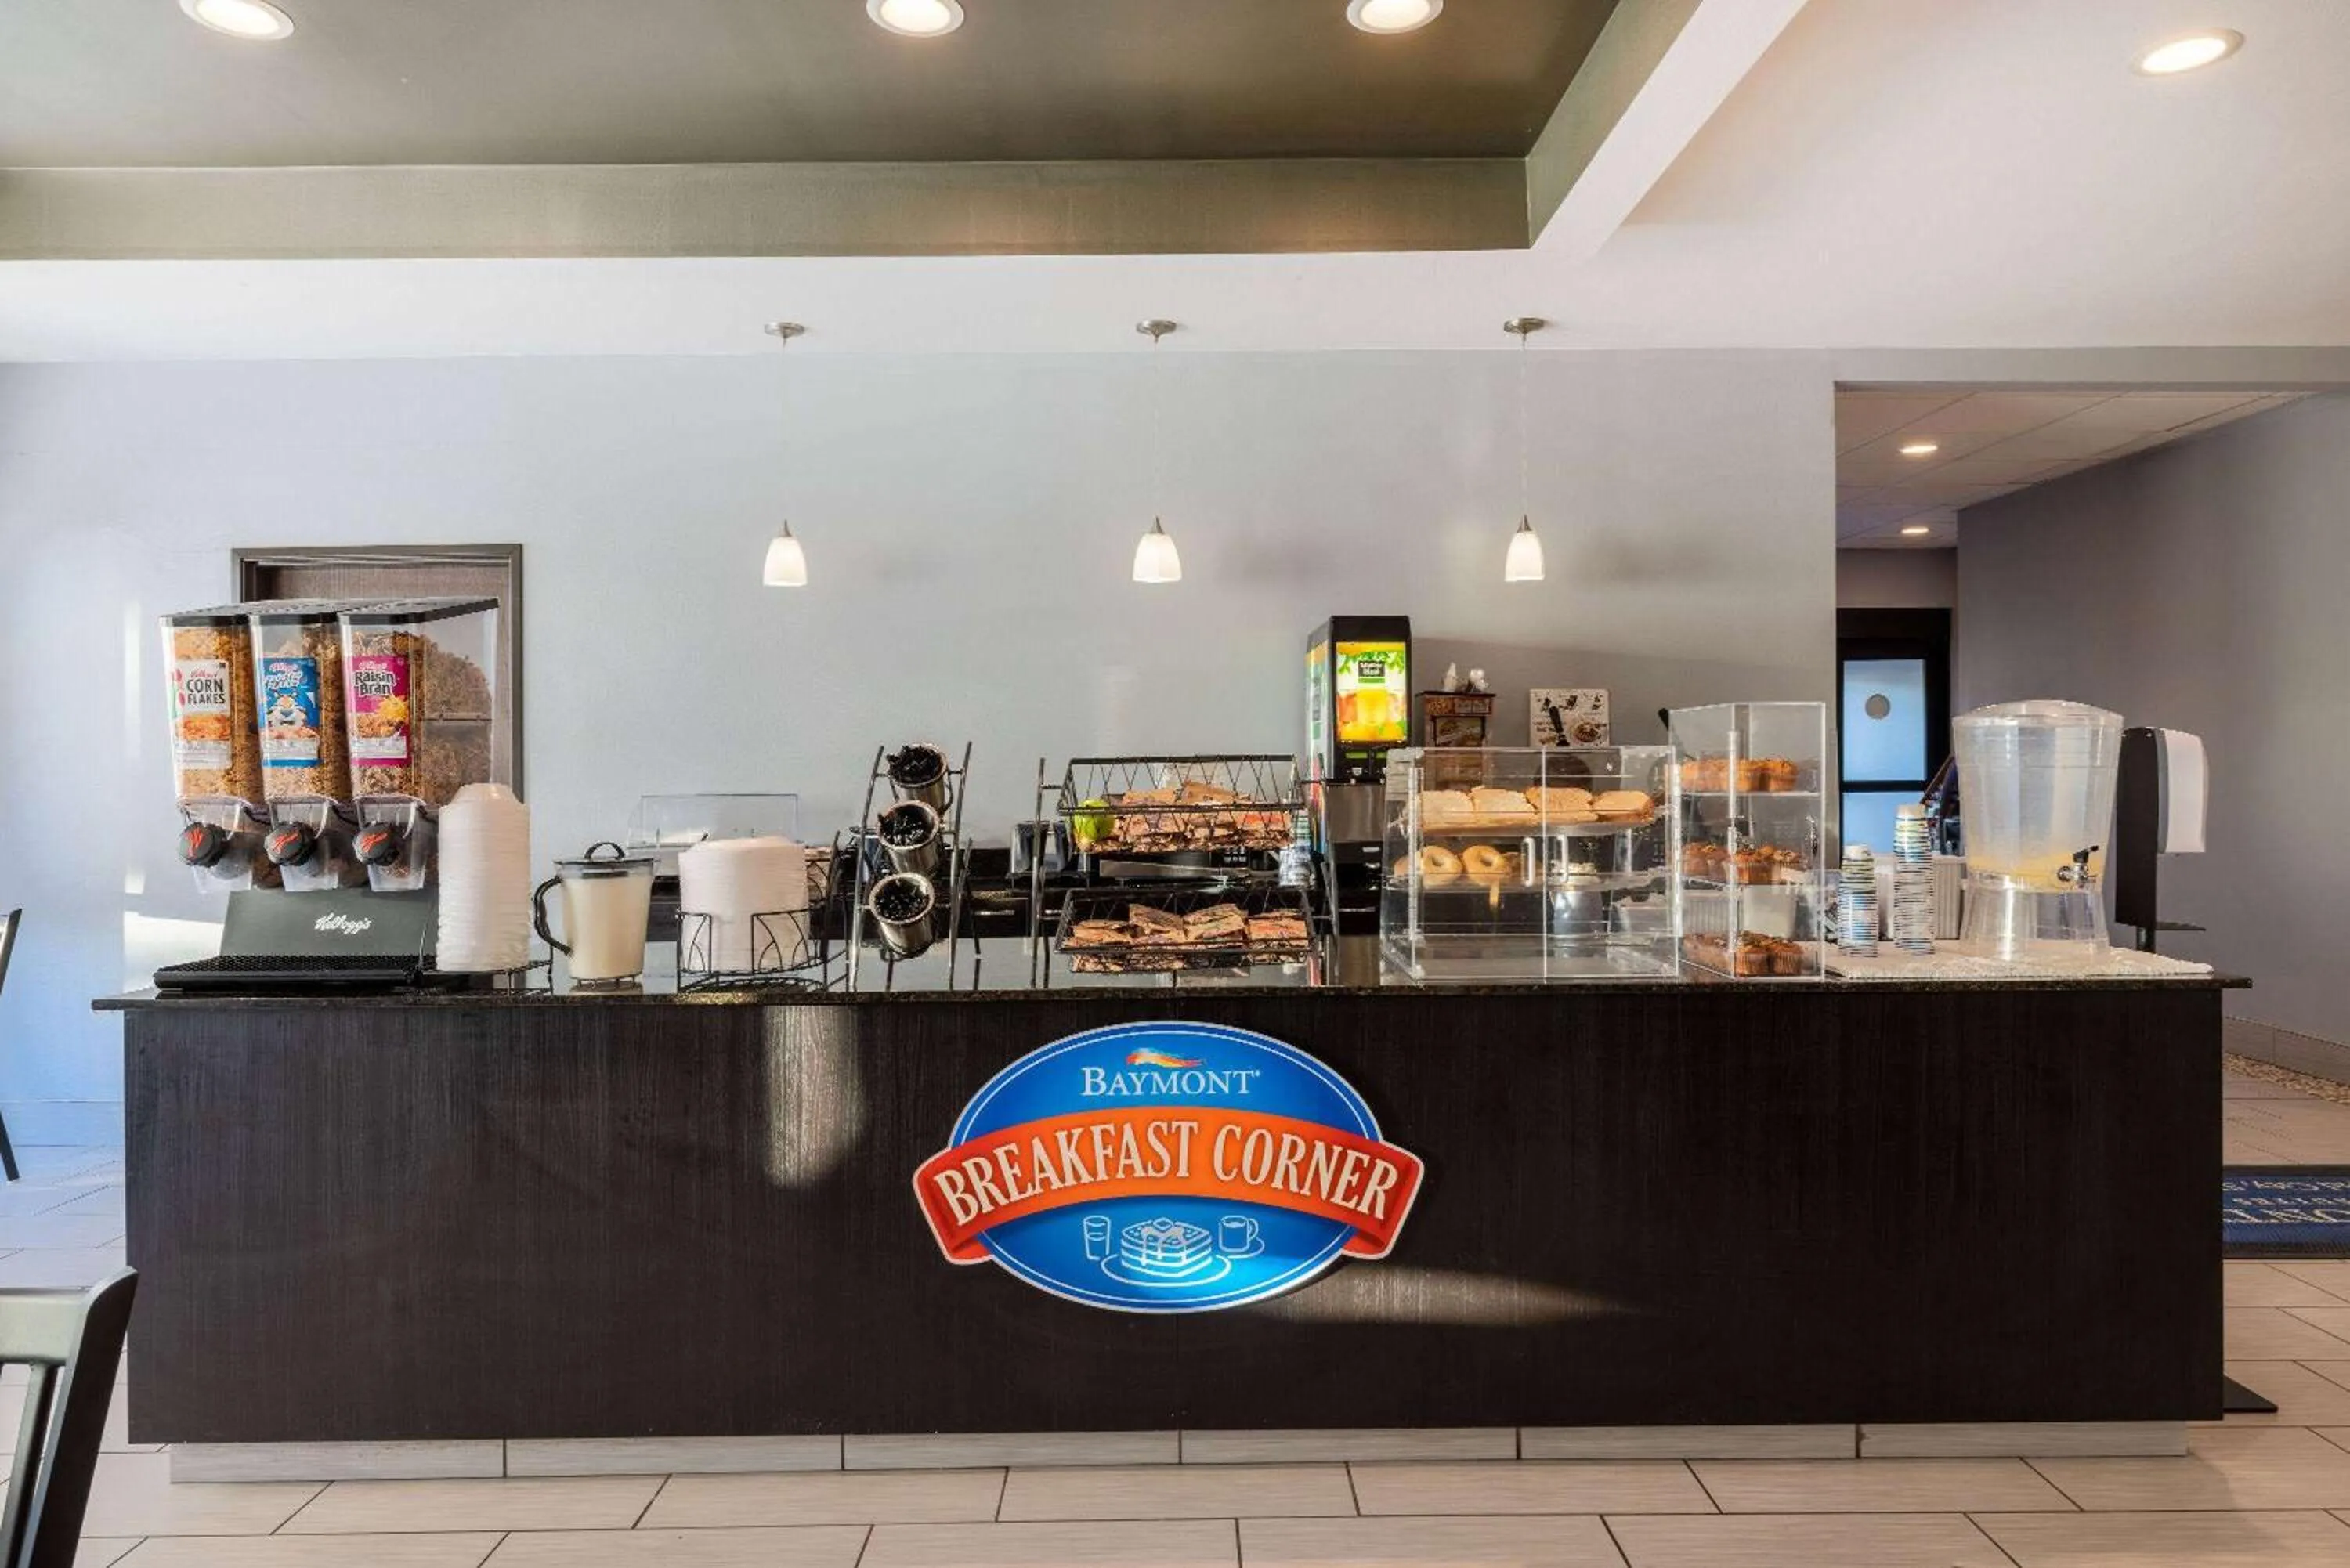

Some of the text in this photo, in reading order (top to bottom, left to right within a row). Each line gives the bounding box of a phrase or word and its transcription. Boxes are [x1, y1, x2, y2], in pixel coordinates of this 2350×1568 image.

[186, 677, 224, 693] CORN
[354, 671, 396, 686] Raisin
[360, 684, 392, 696] Bran
[188, 693, 226, 704] FLAKES
[314, 912, 372, 934] Kellogg's
[1080, 1066, 1255, 1097] BAYMONT
[934, 1121, 1399, 1227] BREAKFAST CORNER
